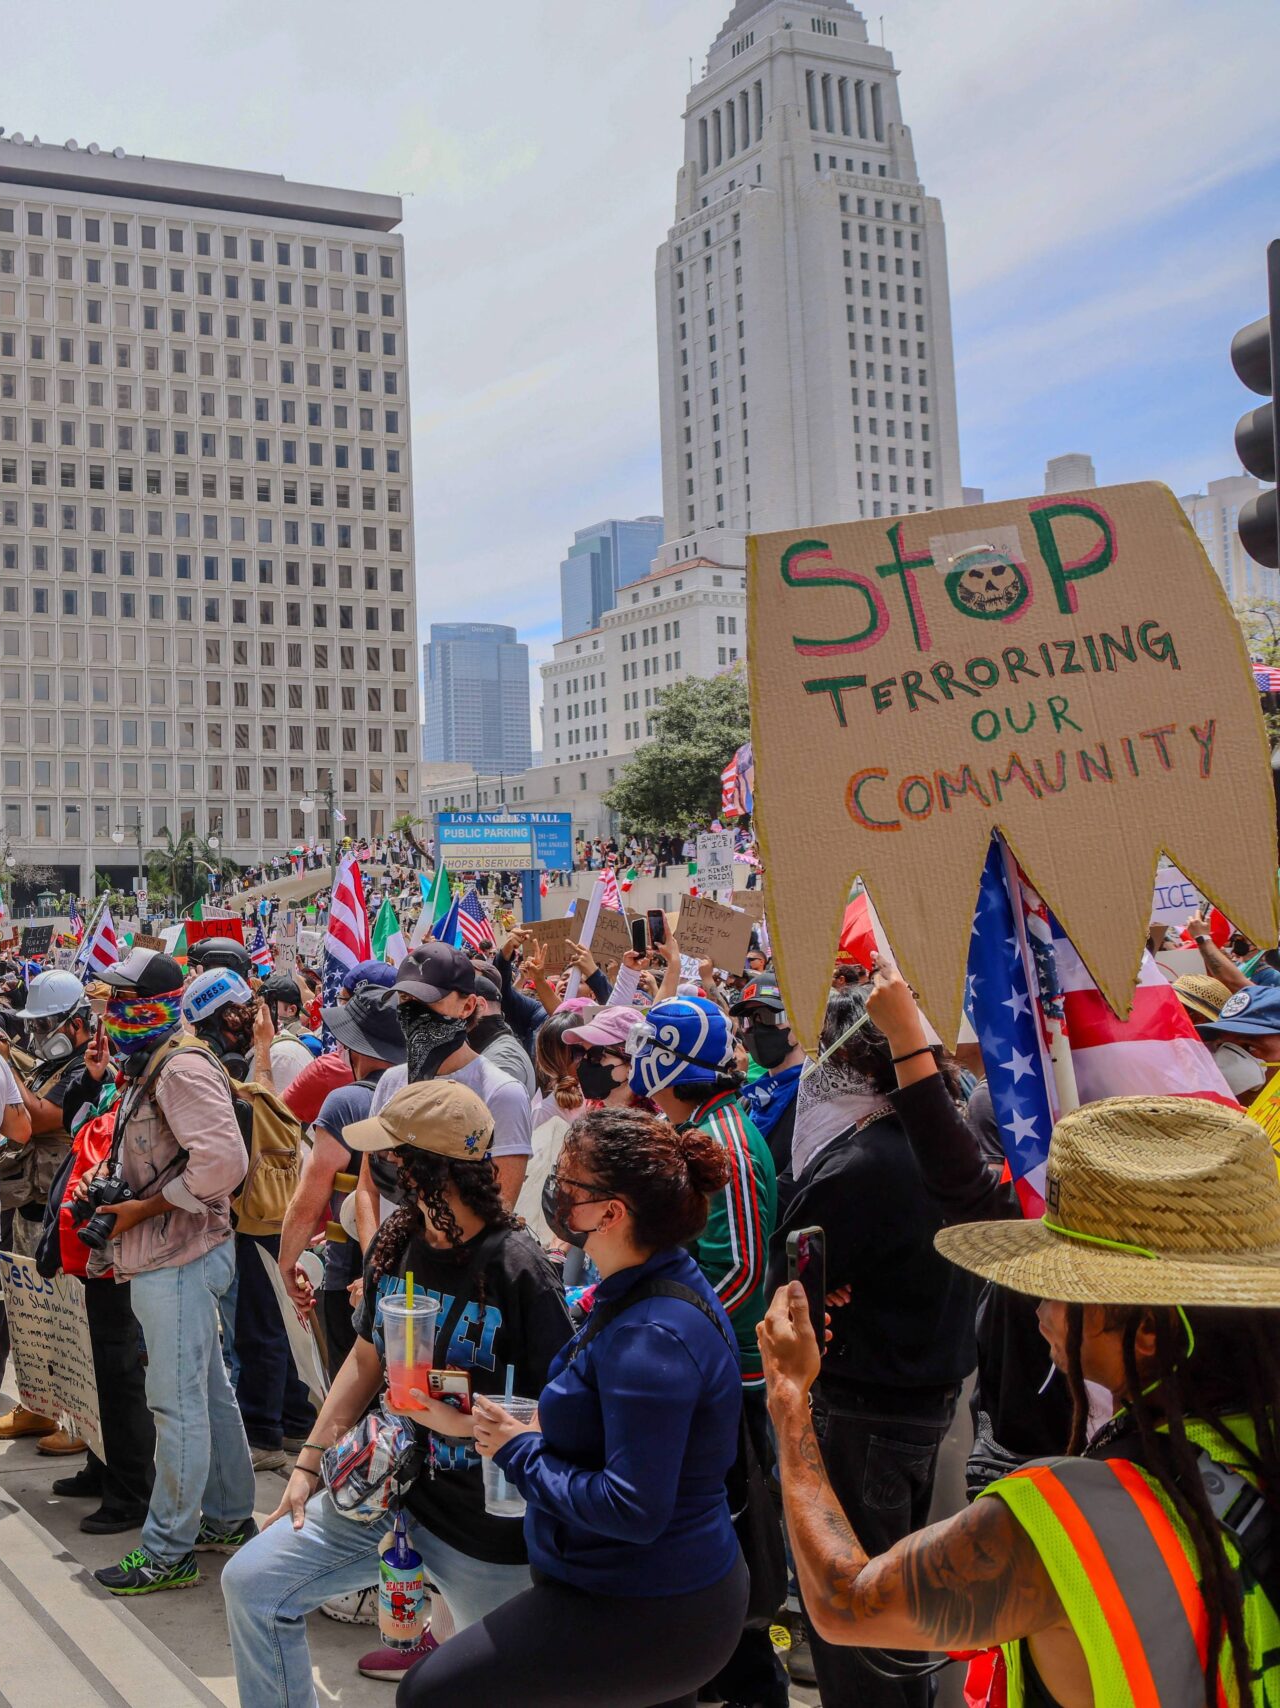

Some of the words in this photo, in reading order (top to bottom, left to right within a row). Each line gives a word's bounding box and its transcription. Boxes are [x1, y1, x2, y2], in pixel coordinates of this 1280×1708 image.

[803, 620, 1180, 727] TERRORIZING
[971, 695, 1082, 743] OUR
[845, 718, 1217, 832] COMMUNITY
[451, 813, 472, 823] LOS
[476, 813, 527, 823] ANGELES
[530, 813, 560, 823] MALL
[444, 828, 481, 838] PUBLIC
[484, 828, 529, 838] PARKING
[456, 846, 481, 855] FOOD
[484, 845, 516, 855] COURT
[484, 858, 531, 868] SERVICES
[1154, 883, 1198, 910] ICE
[682, 898, 703, 918] HEY
[192, 920, 236, 939] LUCHA
[195, 982, 225, 1006] PRESS
[0, 1253, 54, 1296] Jesus
[385, 1581, 404, 1591] BEACH
